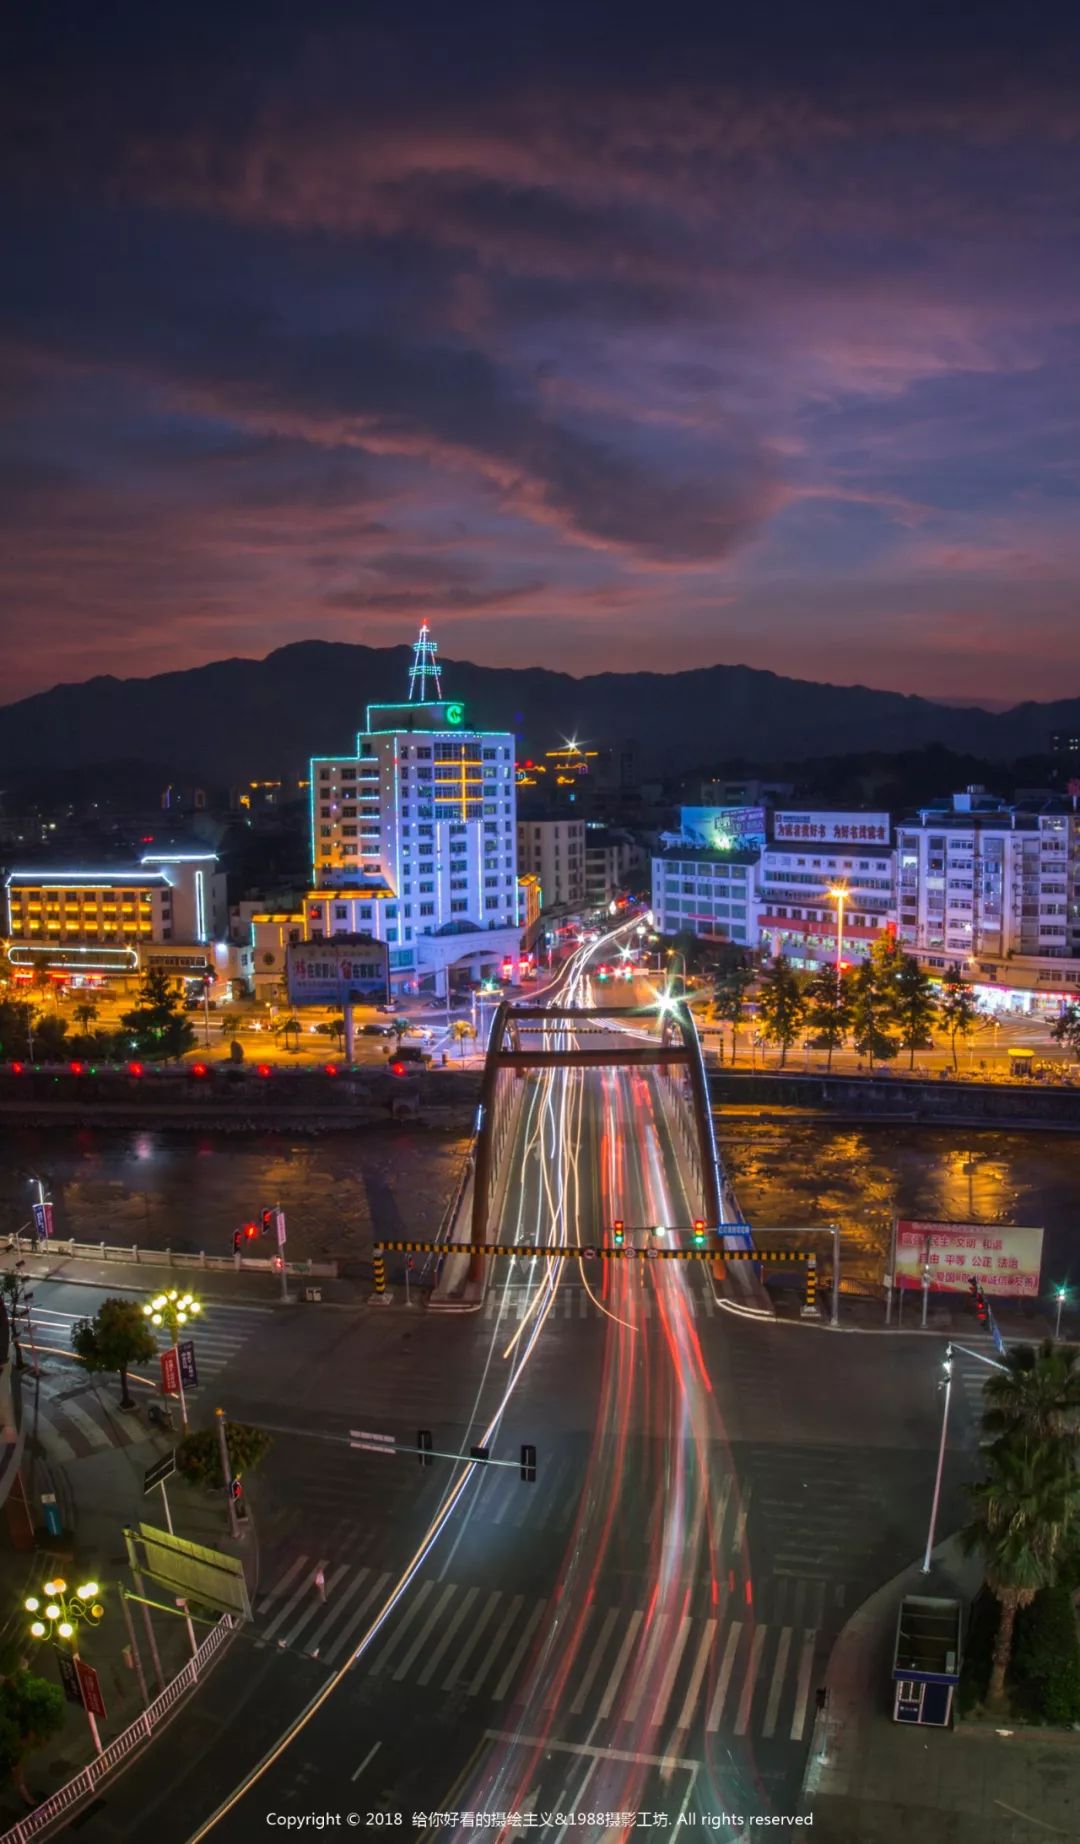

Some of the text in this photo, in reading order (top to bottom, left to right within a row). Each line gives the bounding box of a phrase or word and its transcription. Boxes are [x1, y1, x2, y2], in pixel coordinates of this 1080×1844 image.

[955, 1236, 977, 1249] 文明
[944, 1253, 966, 1266] 平等
[972, 1255, 993, 1268] 公正
